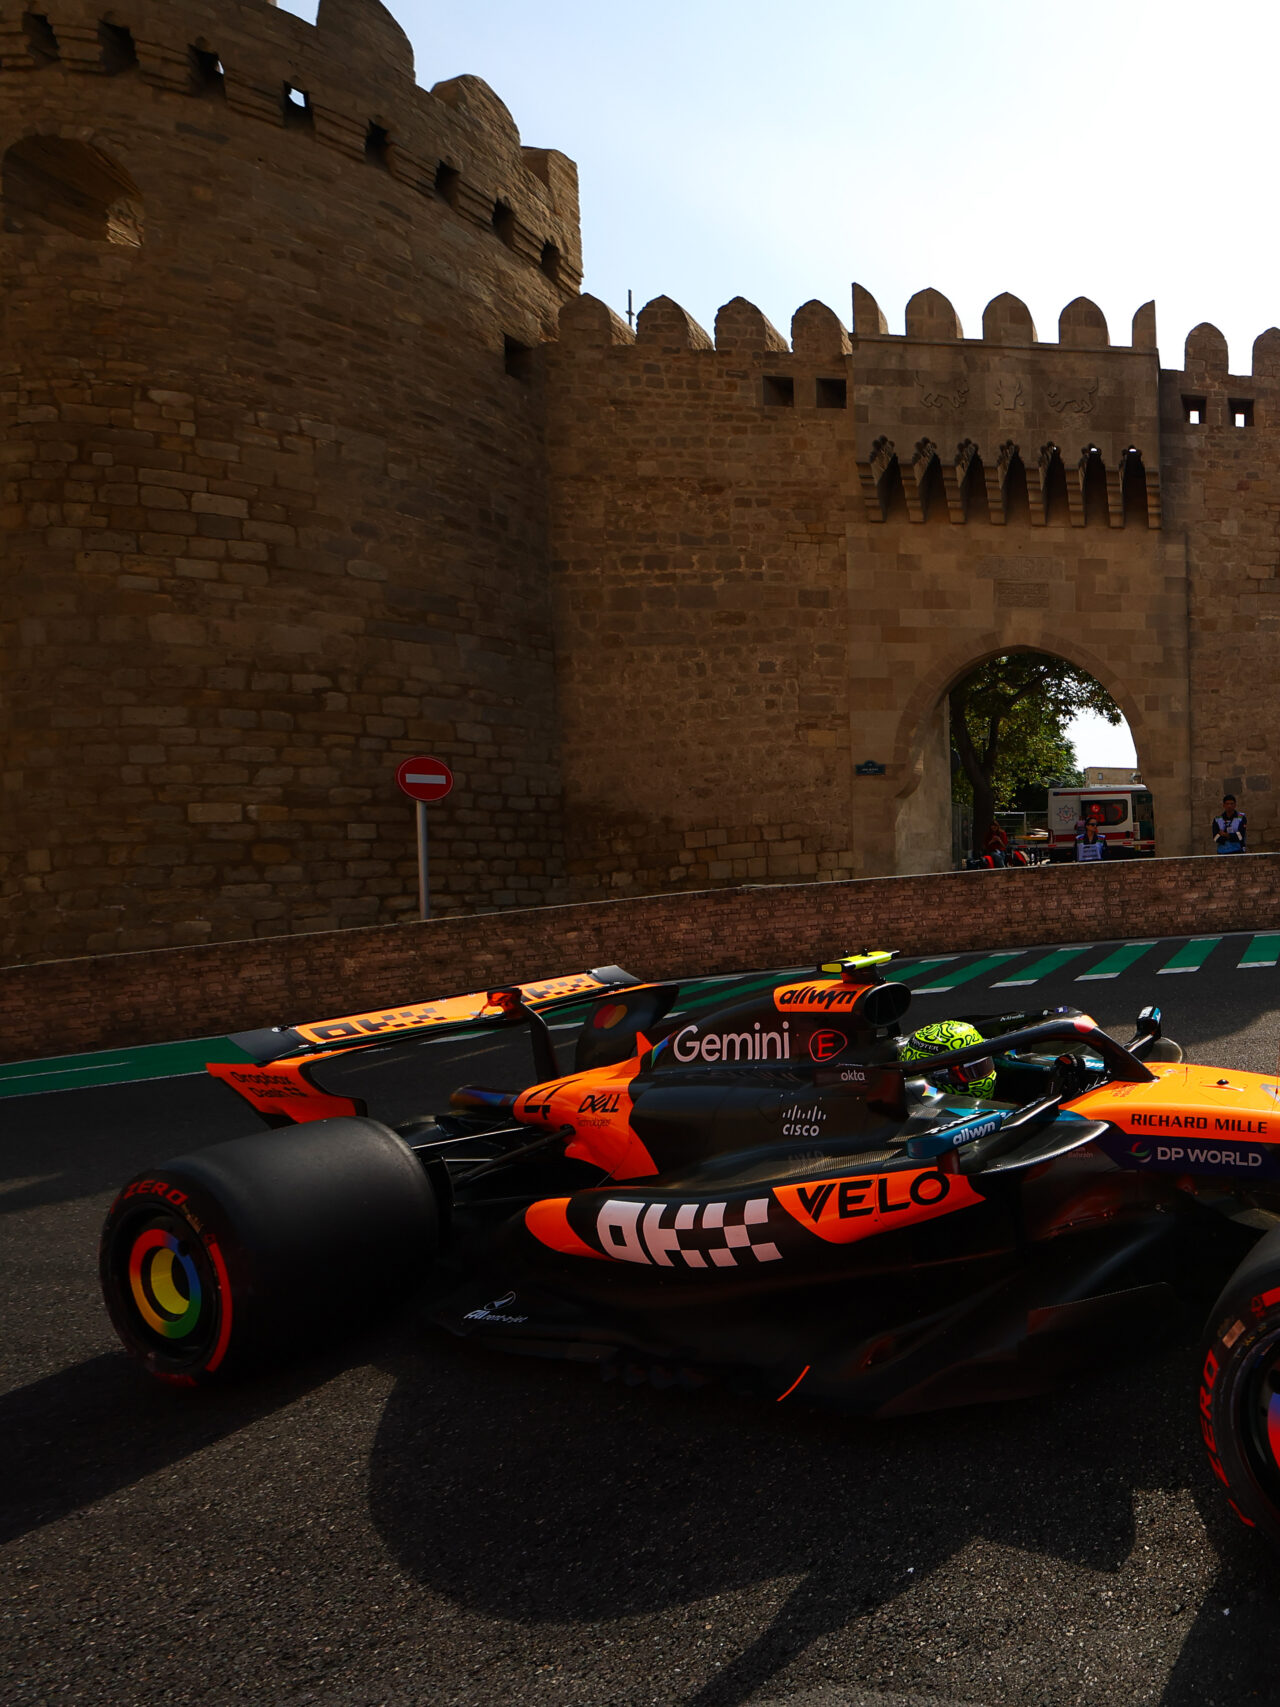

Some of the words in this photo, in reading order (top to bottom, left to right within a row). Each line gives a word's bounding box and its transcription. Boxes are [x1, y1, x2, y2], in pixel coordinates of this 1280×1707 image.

[521, 977, 595, 1002] KX
[779, 986, 857, 1009] allwyn
[673, 1021, 790, 1062] Gemini
[840, 1069, 866, 1081] okta
[577, 1094, 621, 1114] DELL
[782, 1123, 820, 1137] CISCO
[952, 1120, 996, 1146] allwyn
[1131, 1113, 1208, 1130] RICHARD
[1215, 1118, 1268, 1134] MILLE
[1157, 1146, 1184, 1162] DP
[1188, 1148, 1263, 1168] WORLD
[797, 1171, 950, 1223] VELO
[597, 1198, 783, 1268] OKX
